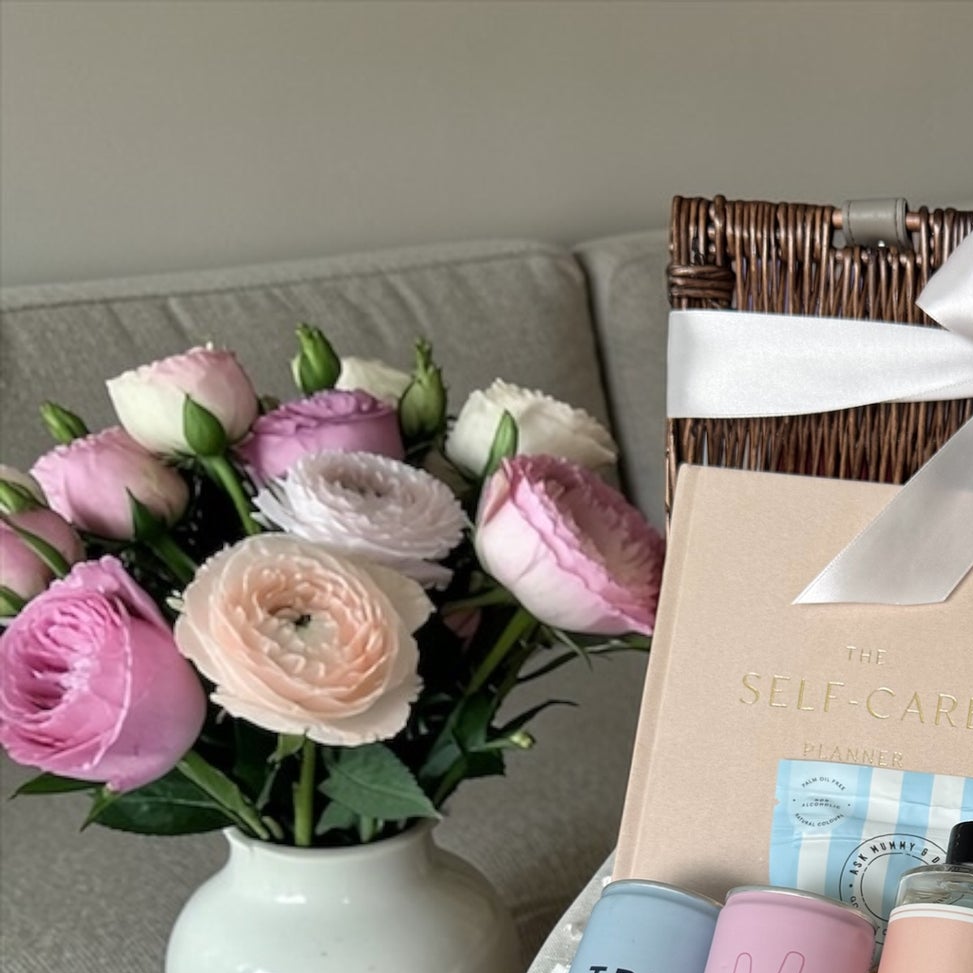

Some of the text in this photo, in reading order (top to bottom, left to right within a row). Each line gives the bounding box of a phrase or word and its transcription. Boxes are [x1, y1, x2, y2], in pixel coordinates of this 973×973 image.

[846, 646, 887, 666] THE
[802, 743, 904, 769] PLANNER
[850, 853, 868, 875] ASK
[870, 841, 916, 854] MUMMY
